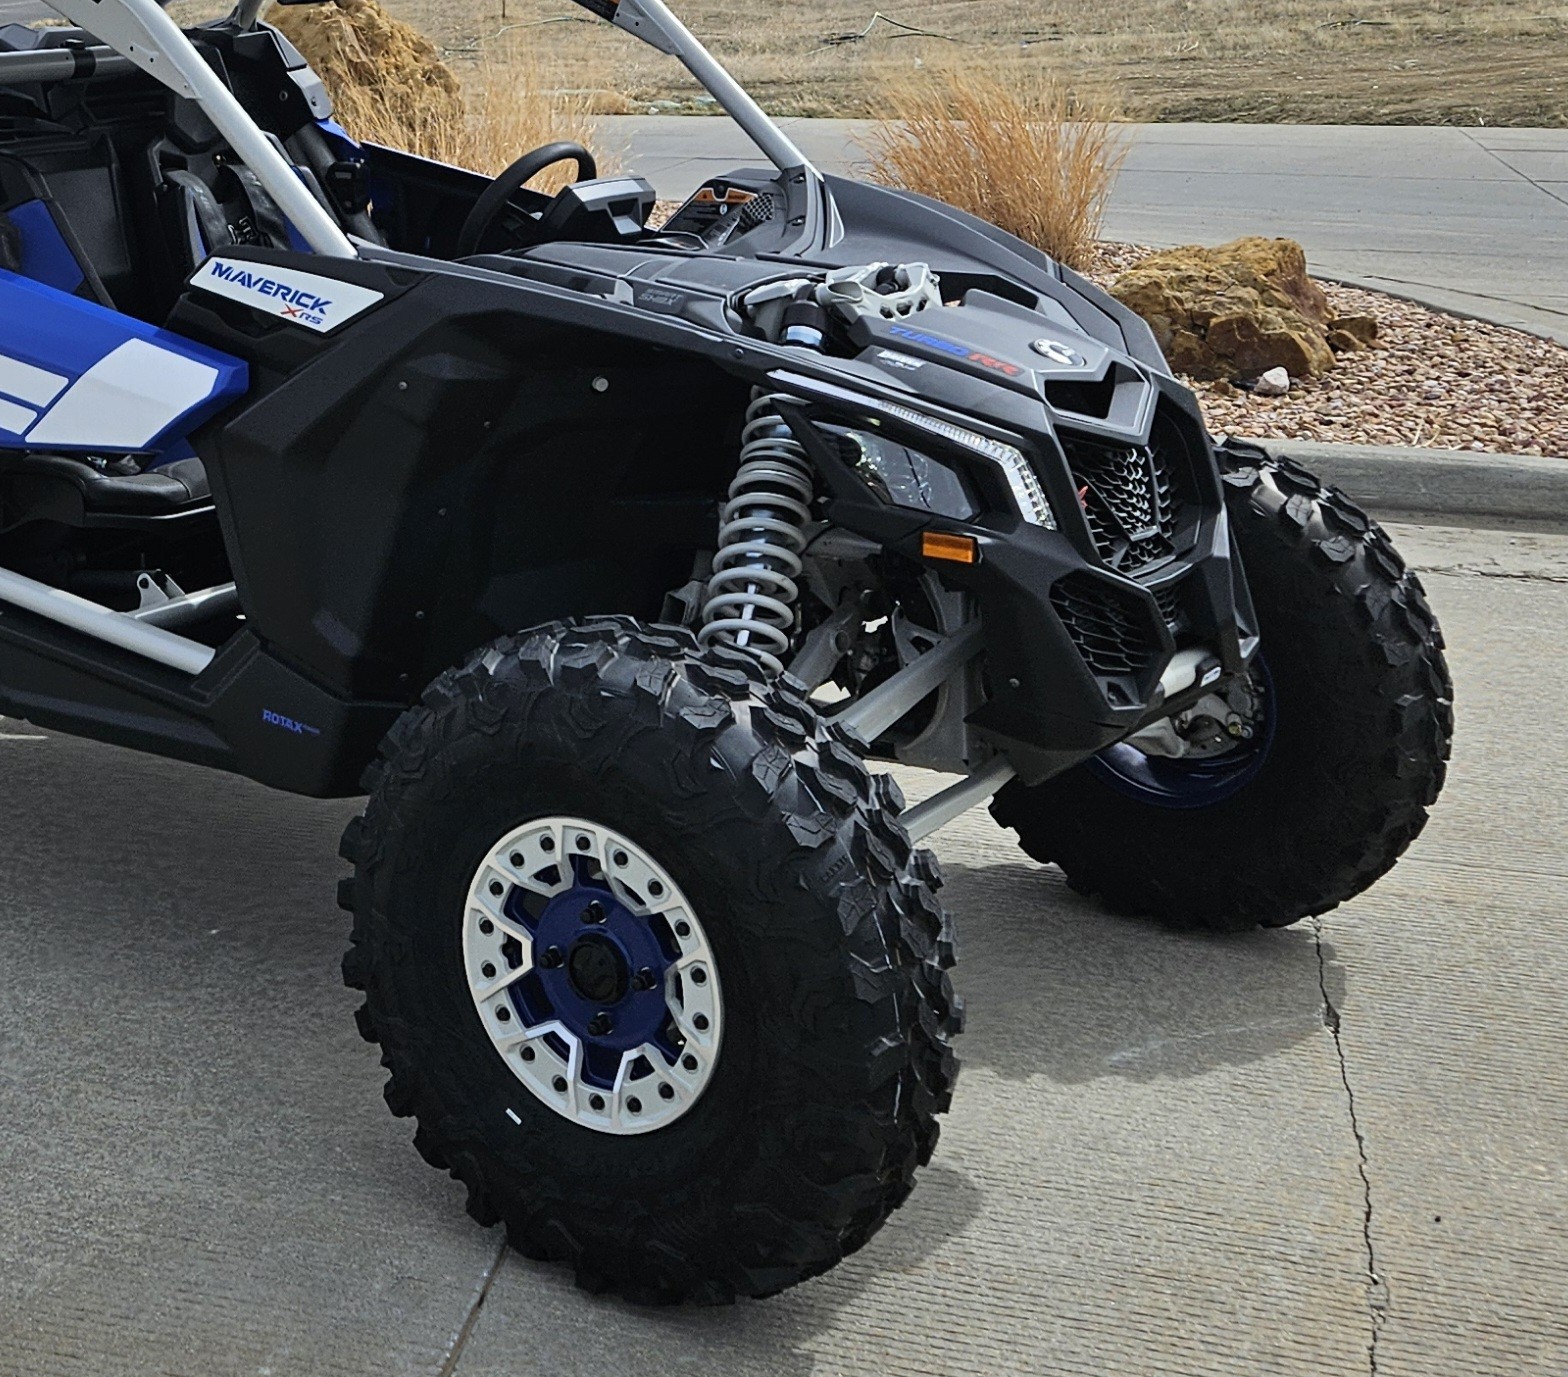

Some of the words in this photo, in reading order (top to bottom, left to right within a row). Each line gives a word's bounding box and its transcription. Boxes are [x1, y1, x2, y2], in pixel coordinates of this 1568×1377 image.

[211, 261, 333, 316] MAVERICK
[889, 325, 970, 357] TURBO
[262, 708, 303, 734] ROTAX
